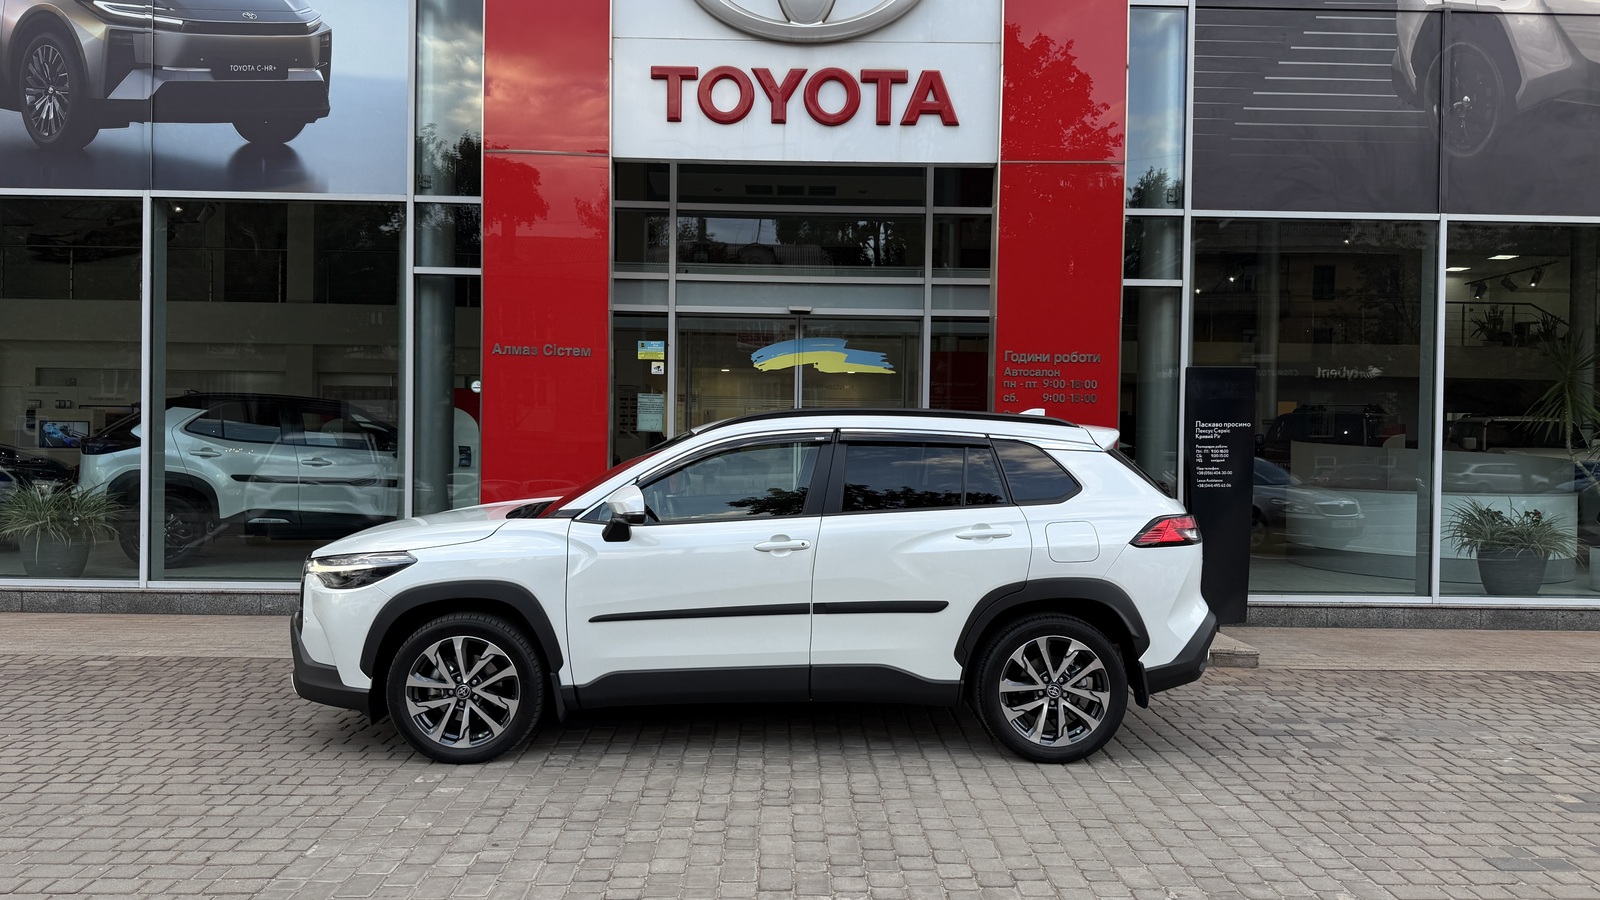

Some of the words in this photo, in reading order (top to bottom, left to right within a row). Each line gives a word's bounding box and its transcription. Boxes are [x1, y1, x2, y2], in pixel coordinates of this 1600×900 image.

[230, 64, 255, 72] TOYOTA
[256, 64, 277, 72] C-HR+
[650, 65, 960, 127] TOYOTA
[491, 342, 539, 356] Алмаз
[542, 343, 592, 358] Сістем
[1003, 350, 1051, 364] Години
[1053, 351, 1101, 366] роботи
[1003, 367, 1061, 377] Автосалон
[1003, 380, 1017, 389] пн
[1025, 381, 1037, 389] пт
[1002, 392, 1019, 403] сб.
[1195, 420, 1223, 428] Ласкаво
